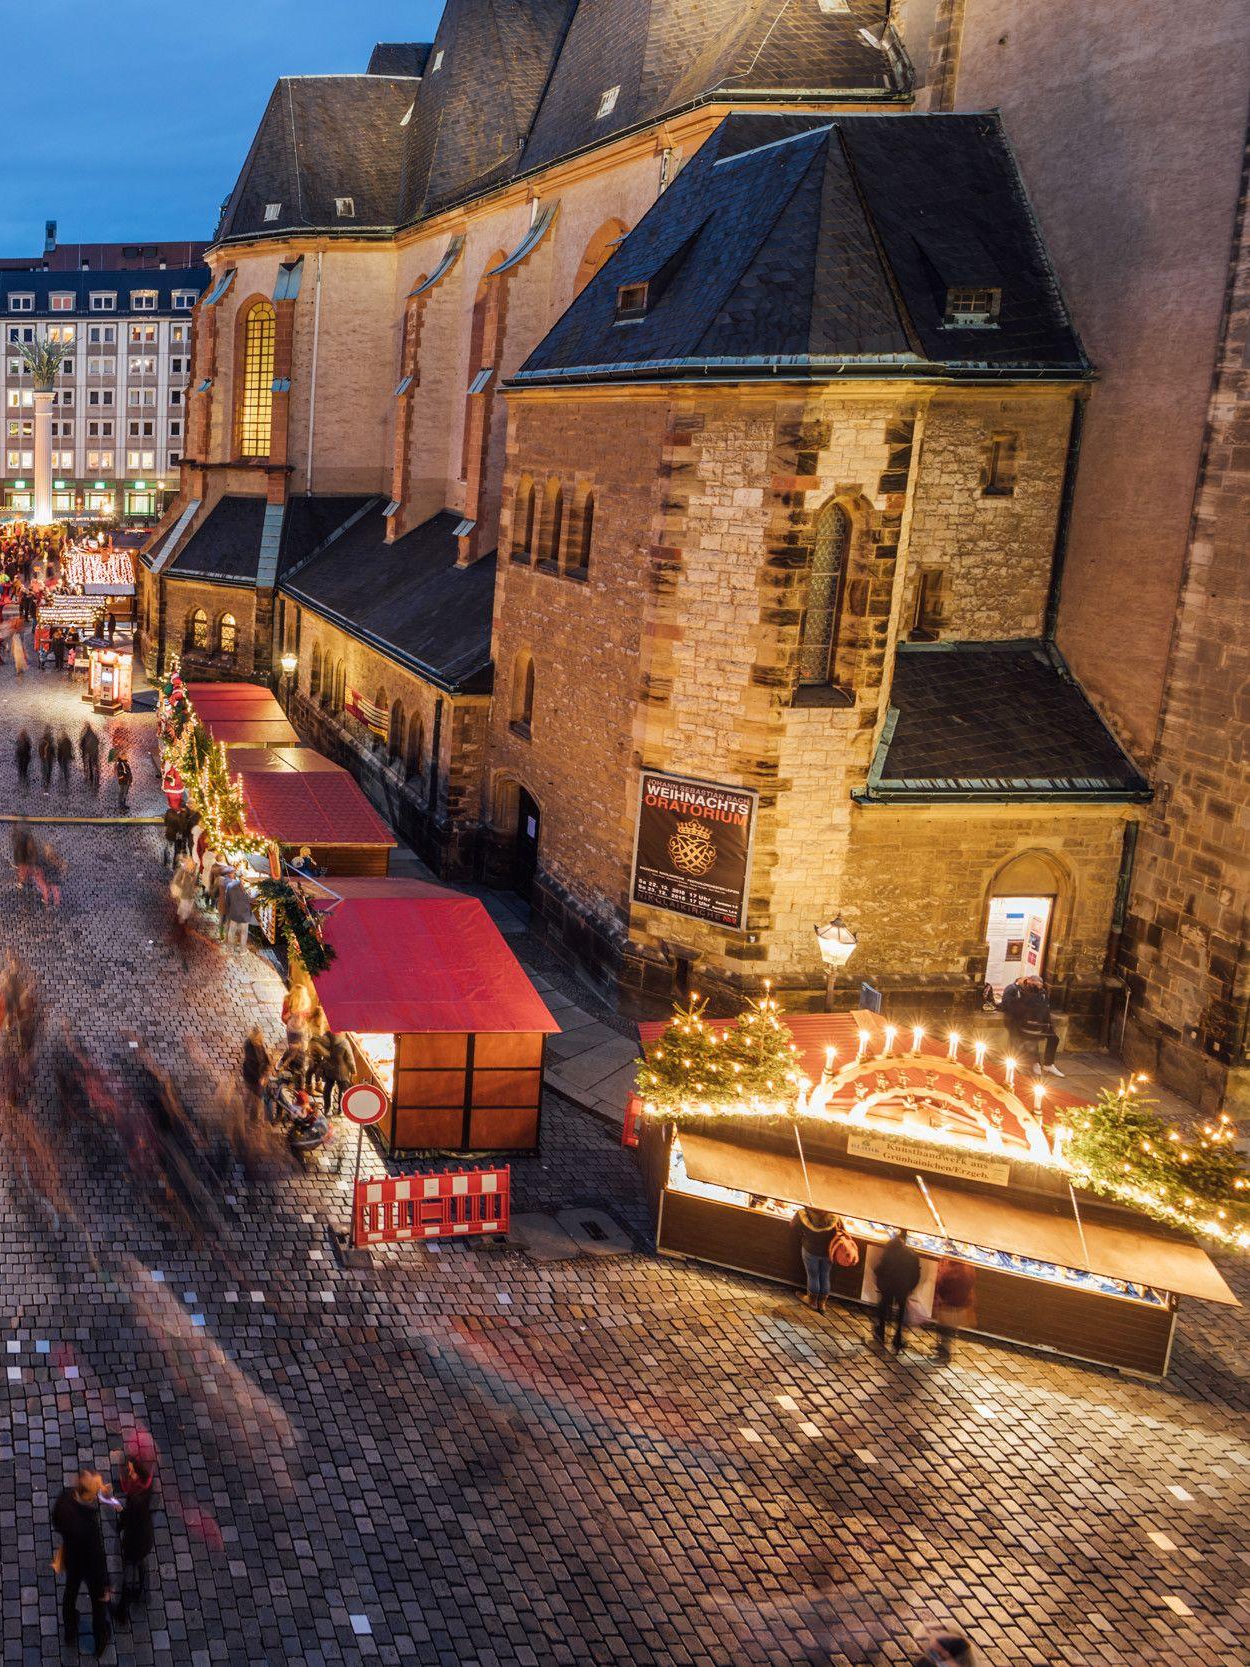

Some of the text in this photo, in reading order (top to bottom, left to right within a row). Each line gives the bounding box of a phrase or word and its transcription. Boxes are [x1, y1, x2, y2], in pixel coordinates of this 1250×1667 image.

[646, 779, 750, 805] JOHANN SEBASTIAN BACH
[646, 784, 749, 815] WEIHNACHTS
[645, 794, 749, 827] ORATORIUM
[886, 1143, 988, 1170] Kunsthandwerk aus
